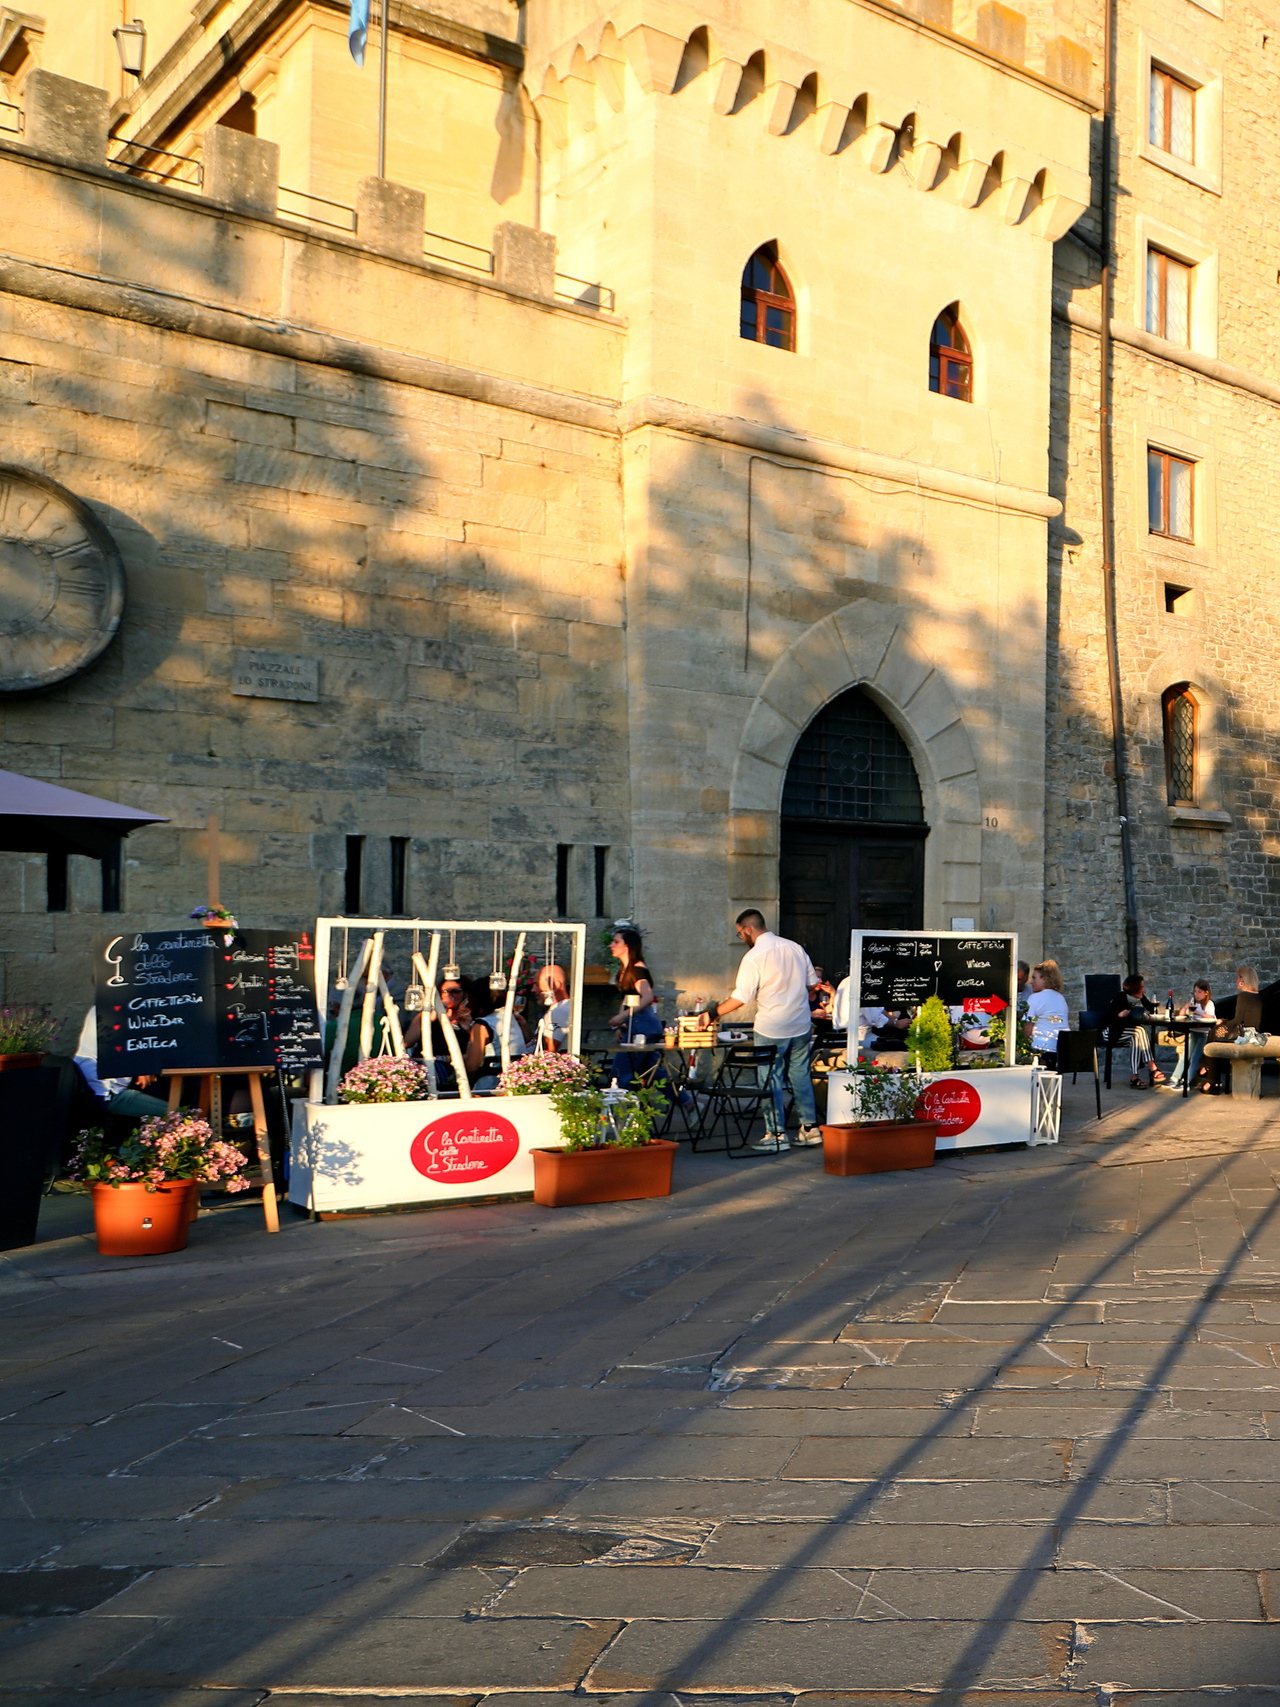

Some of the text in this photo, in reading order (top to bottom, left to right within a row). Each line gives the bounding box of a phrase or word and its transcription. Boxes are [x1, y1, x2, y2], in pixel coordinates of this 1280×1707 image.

[249, 661, 302, 674] PIAZZALE
[238, 675, 313, 691] LO STRADONE
[985, 816, 998, 828] 10
[127, 1036, 178, 1051] ENOTECA
[441, 1126, 504, 1146] la Cantinetta
[442, 1155, 489, 1173] Stradone
